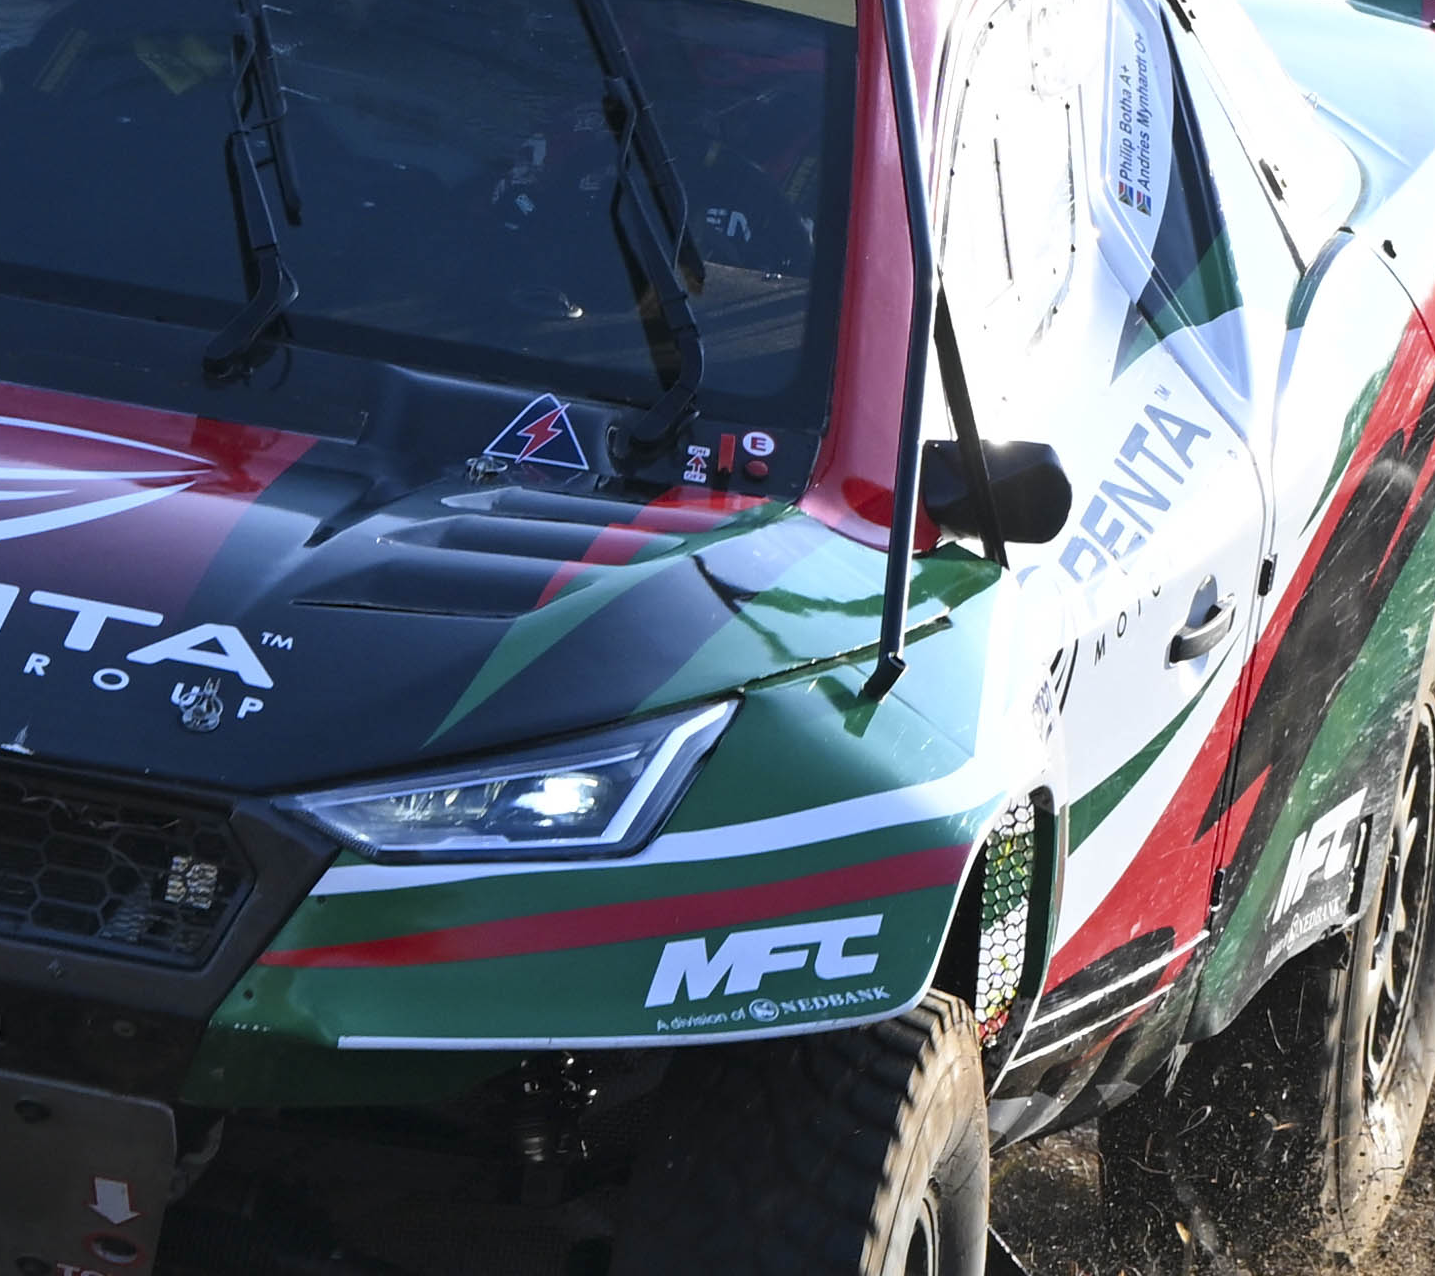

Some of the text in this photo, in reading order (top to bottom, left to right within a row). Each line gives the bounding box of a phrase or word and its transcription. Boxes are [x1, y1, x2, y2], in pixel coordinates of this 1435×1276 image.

[1119, 64, 1135, 182] Philip Botha A+
[1136, 55, 1153, 126] Mynhardt
[1137, 132, 1151, 191] Andries
[750, 436, 767, 452] E
[1272, 787, 1368, 925] MFC
[644, 913, 884, 1008] MFC
[656, 986, 891, 1032] A division of NEDBANK
